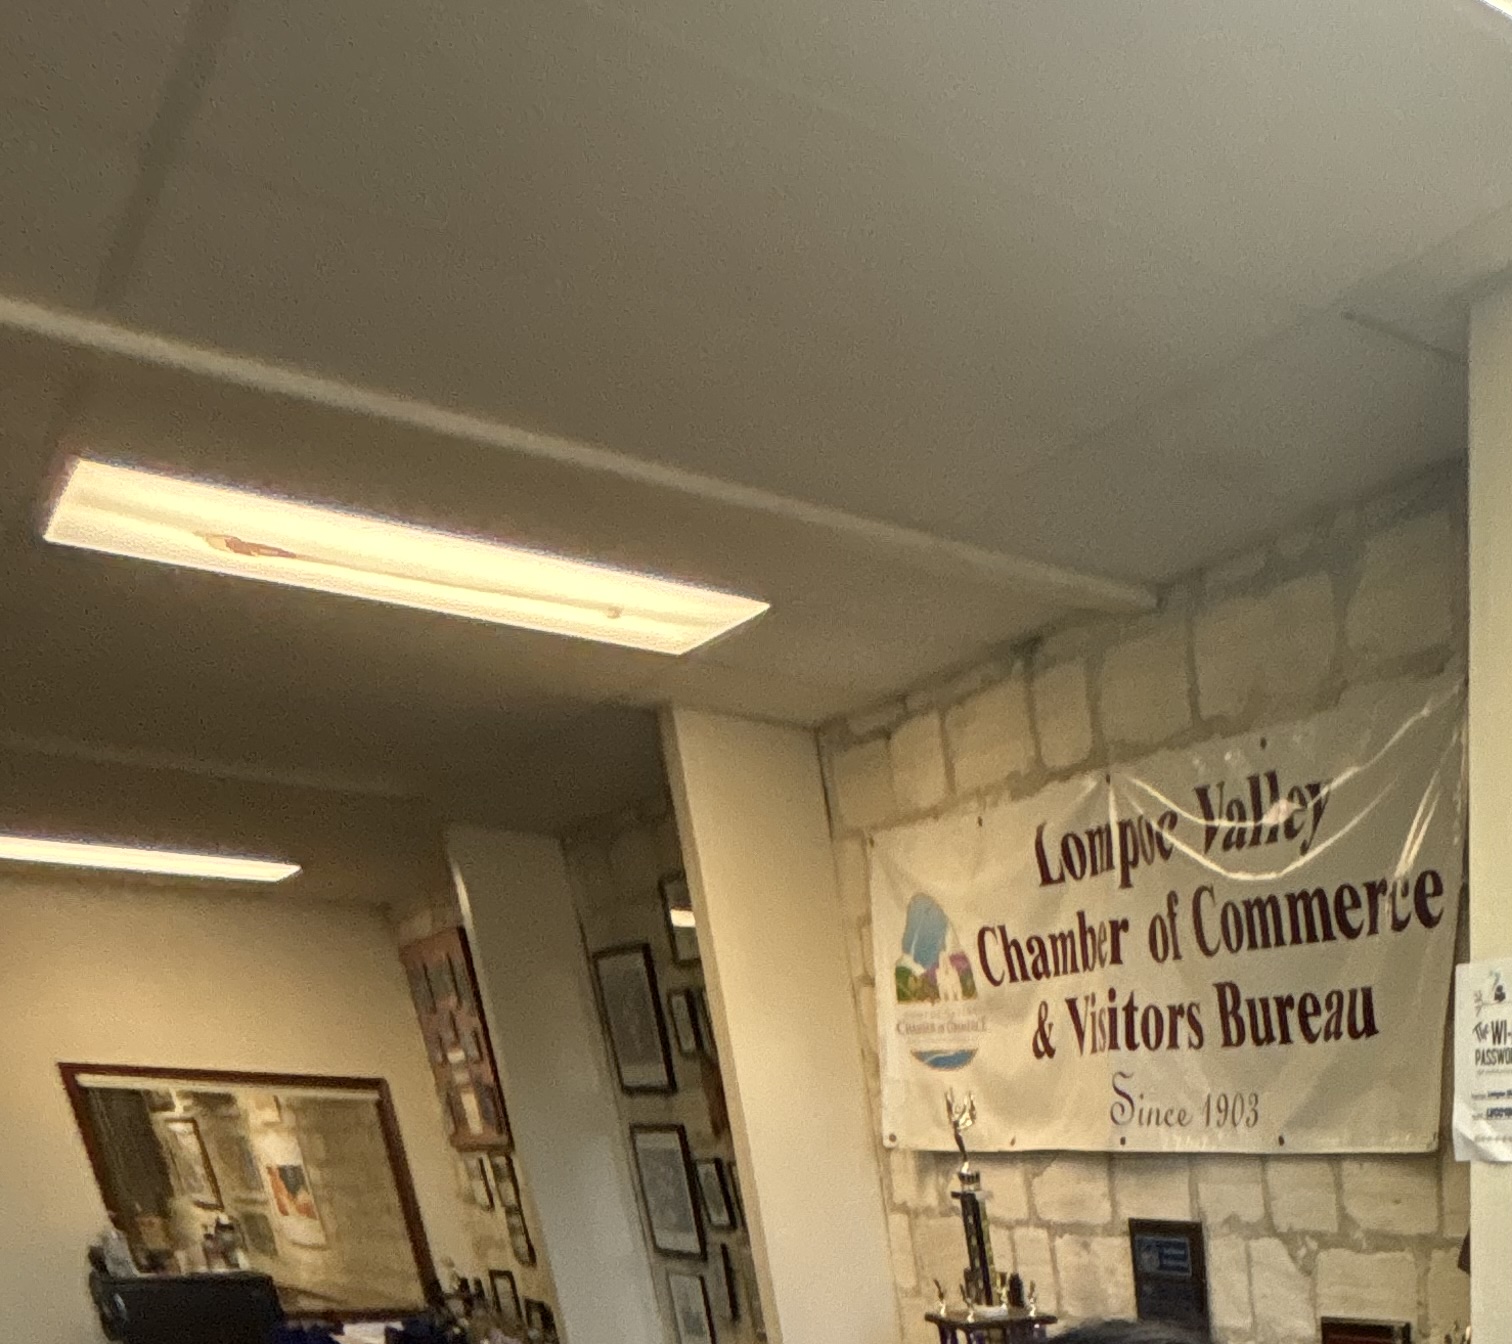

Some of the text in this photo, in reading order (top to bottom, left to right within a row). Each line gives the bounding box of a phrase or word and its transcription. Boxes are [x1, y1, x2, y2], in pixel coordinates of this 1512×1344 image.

[1034, 769, 1331, 888] Lompoc Valley
[977, 869, 1444, 987] Chamber of Commerce
[1032, 980, 1379, 1060] & Visitors Bureau
[1110, 1071, 1259, 1128] Since 1903
